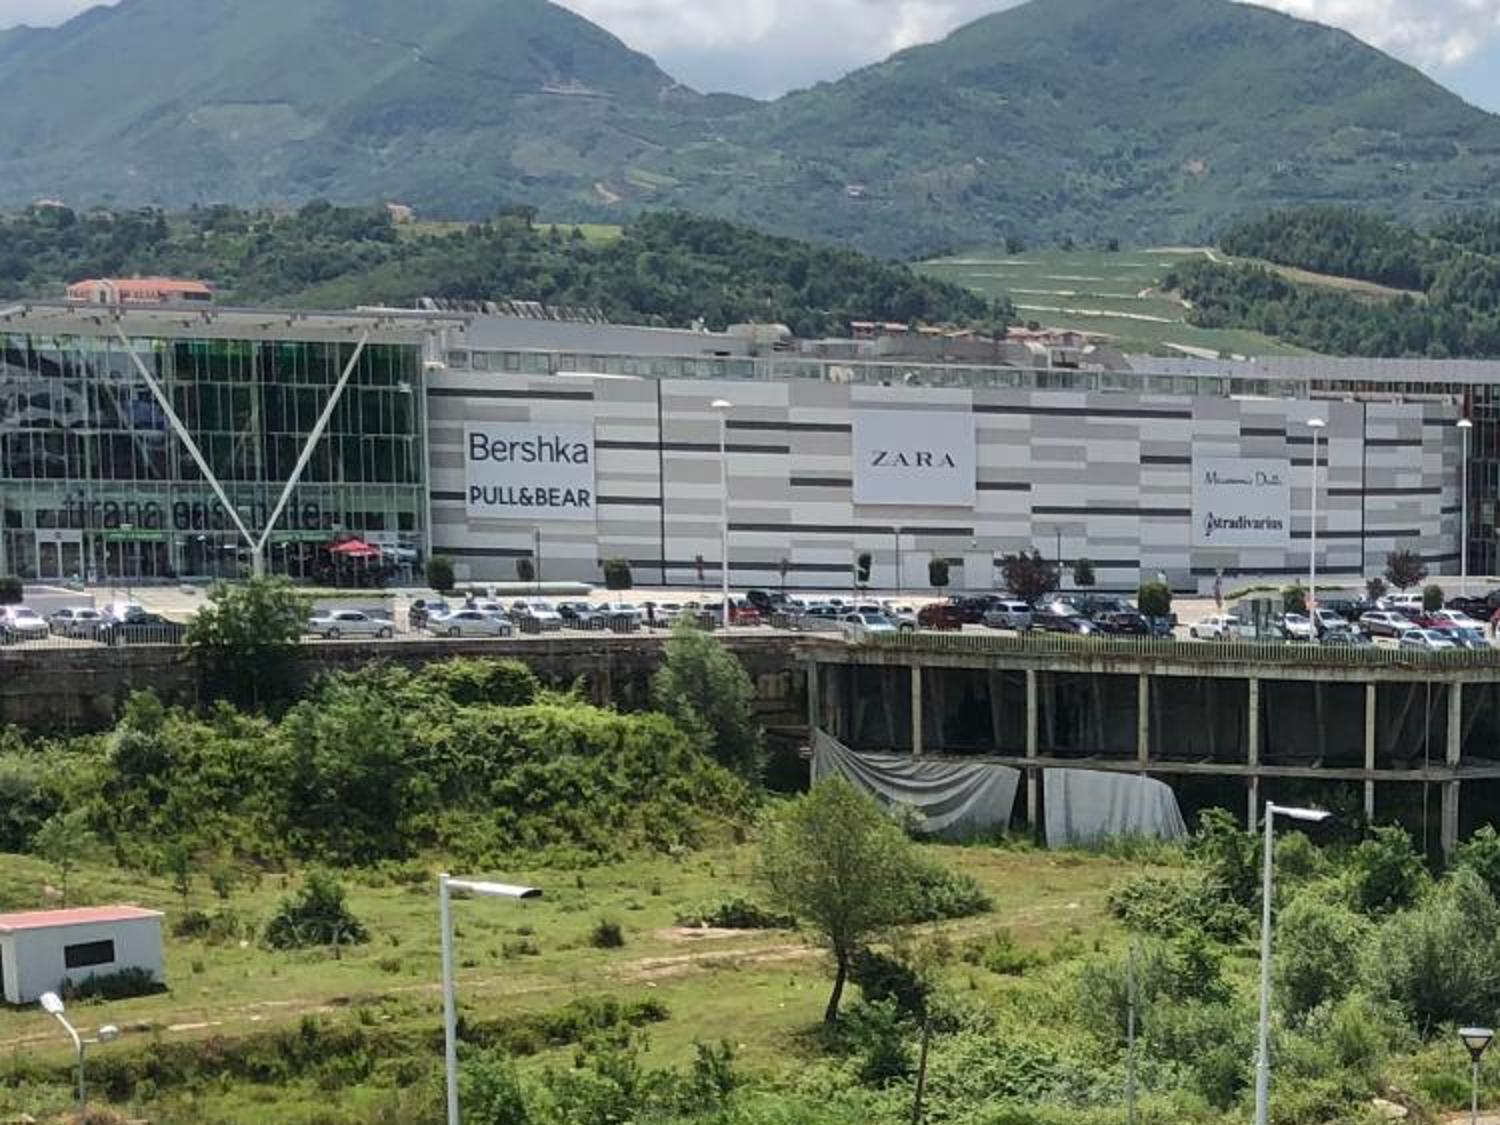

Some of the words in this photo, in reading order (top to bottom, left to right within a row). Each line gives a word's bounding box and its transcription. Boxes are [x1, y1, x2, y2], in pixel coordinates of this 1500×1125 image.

[469, 432, 589, 463] Bershka
[872, 451, 955, 467] ZARA
[469, 486, 590, 507] PULL&BEAR
